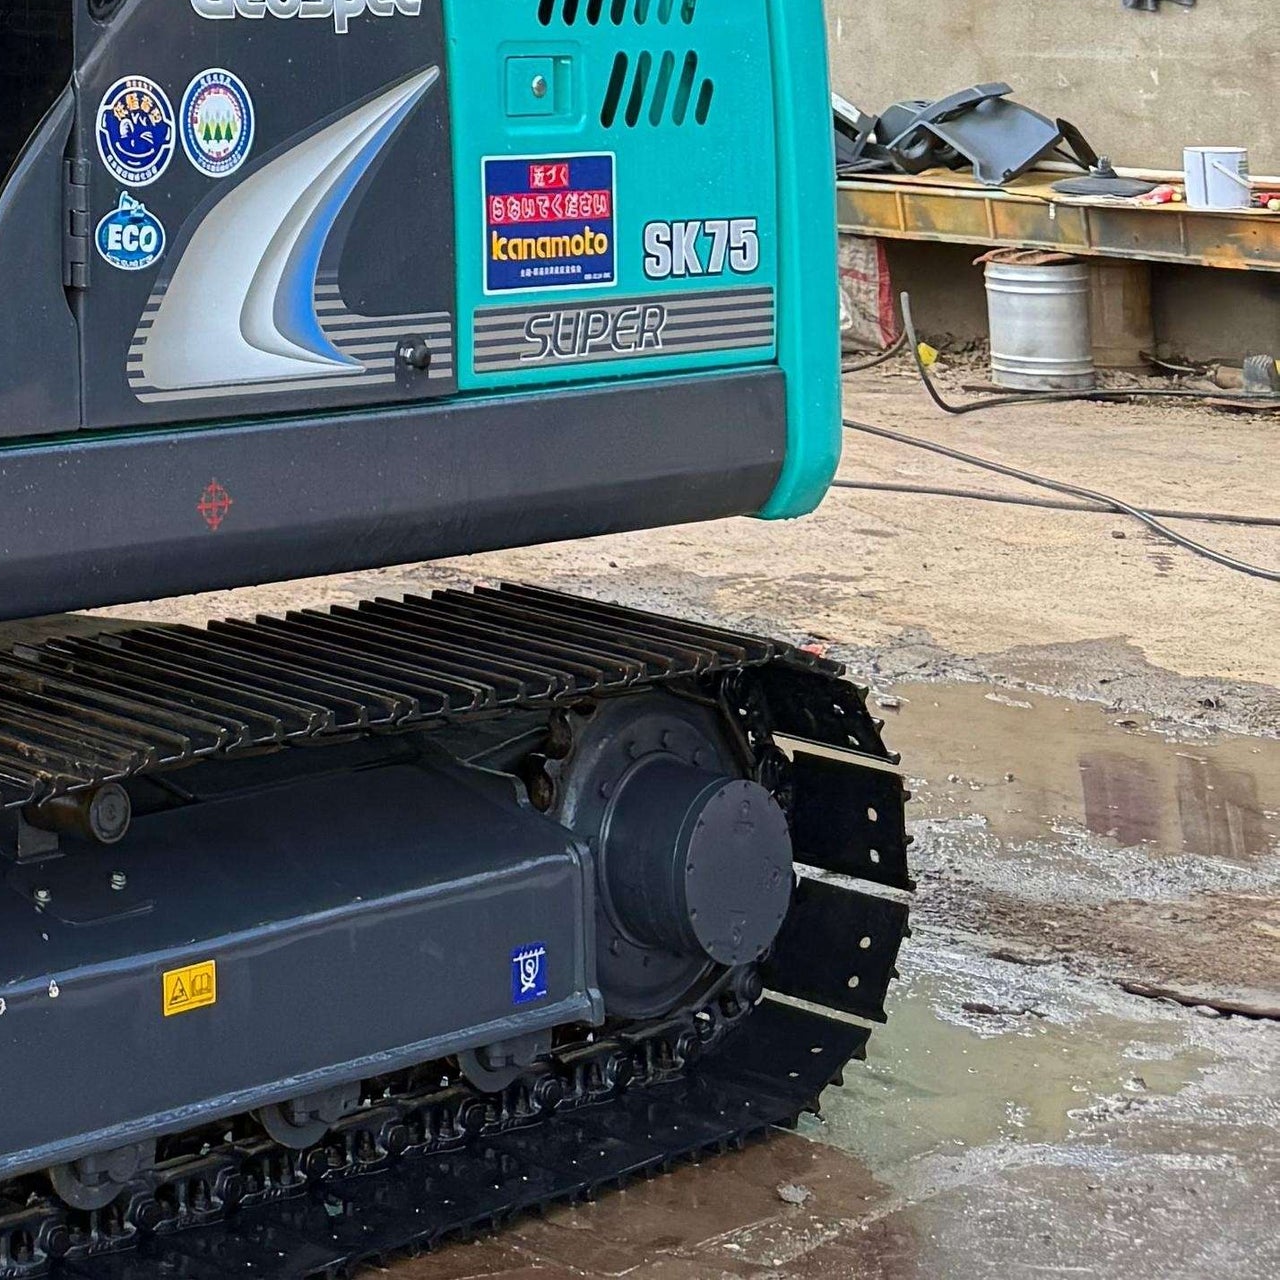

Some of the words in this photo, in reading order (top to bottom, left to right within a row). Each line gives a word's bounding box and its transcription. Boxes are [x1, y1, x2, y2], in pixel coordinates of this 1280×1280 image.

[107, 224, 157, 252] ECO
[491, 225, 608, 260] kanamoto
[644, 218, 760, 278] SK75
[520, 304, 668, 362] SUPER
